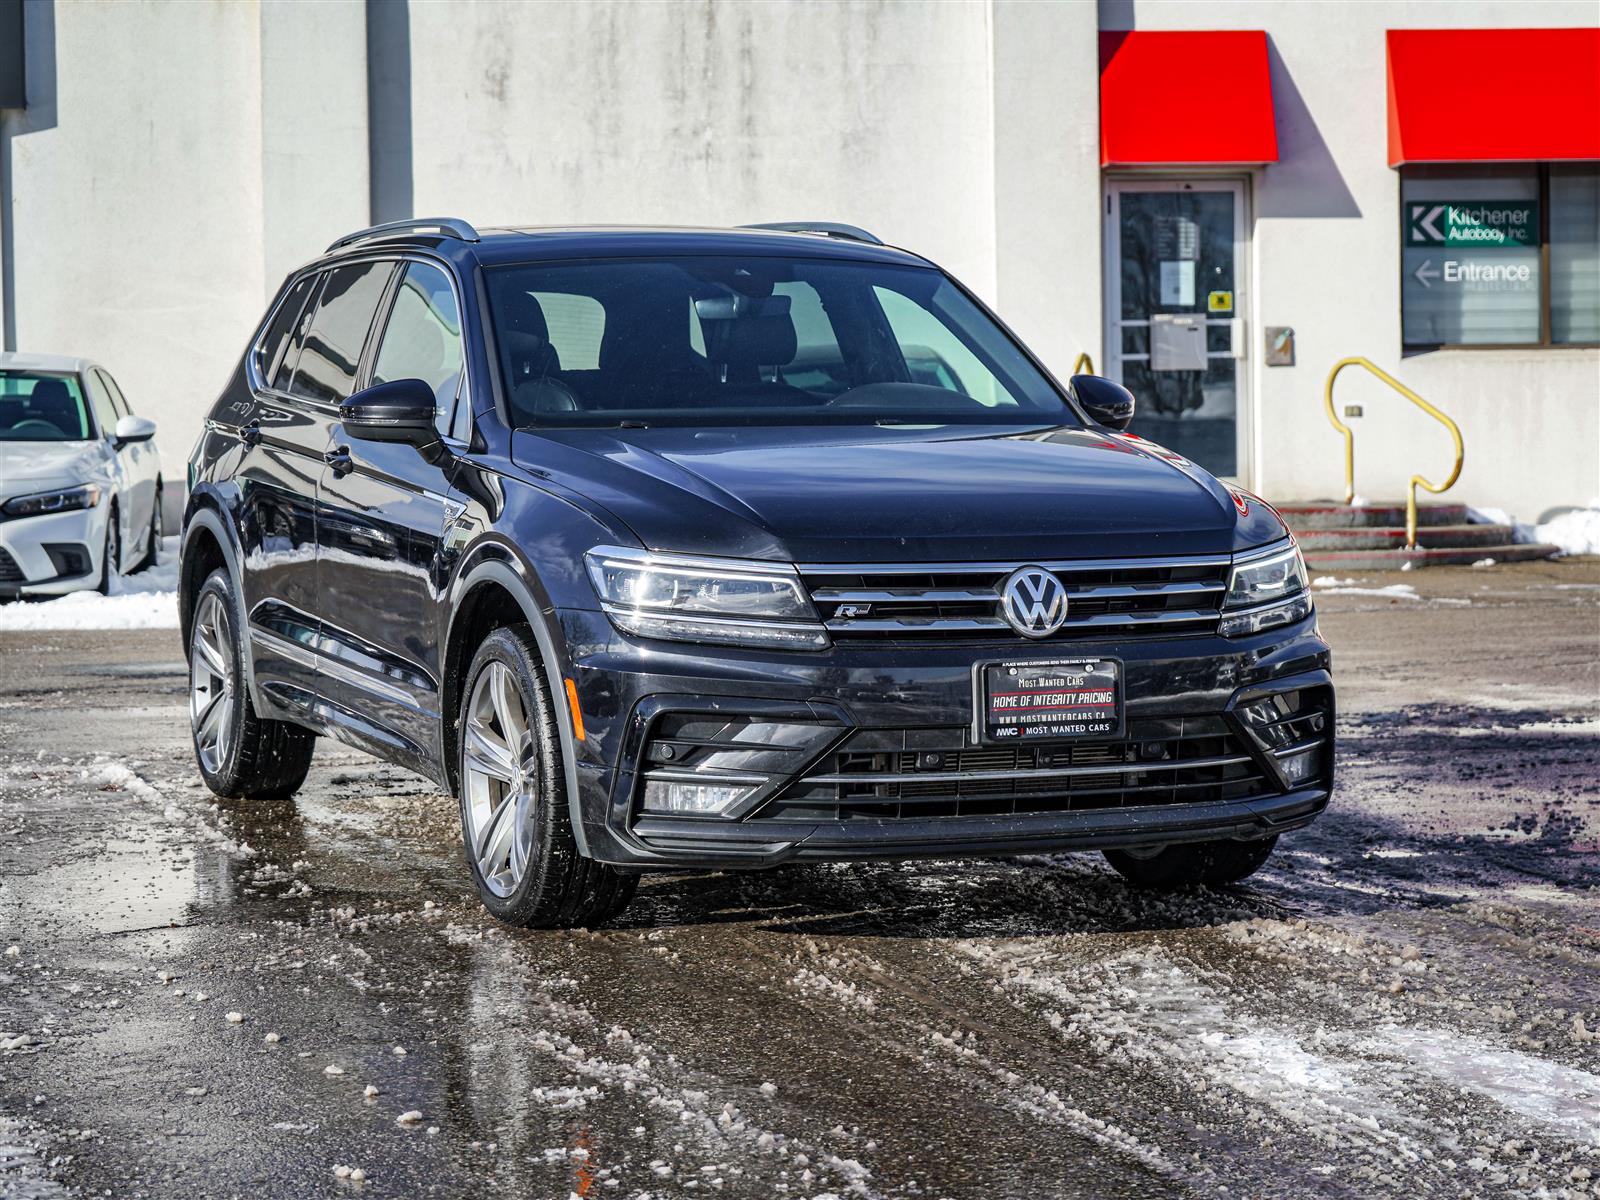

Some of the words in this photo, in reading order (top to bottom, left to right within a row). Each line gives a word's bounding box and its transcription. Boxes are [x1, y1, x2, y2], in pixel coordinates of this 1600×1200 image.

[1448, 206, 1530, 226] Kitchener
[1448, 226, 1505, 243] Autobody
[1444, 260, 1530, 282] Entrance
[993, 696, 1018, 708] HOME
[1020, 695, 1031, 707] OF
[1033, 693, 1076, 706] INTEGRITY
[1078, 691, 1112, 704] PRICING
[1026, 726, 1048, 735] MOST
[1051, 724, 1086, 734] WANTED
[1088, 723, 1110, 732] CARS
